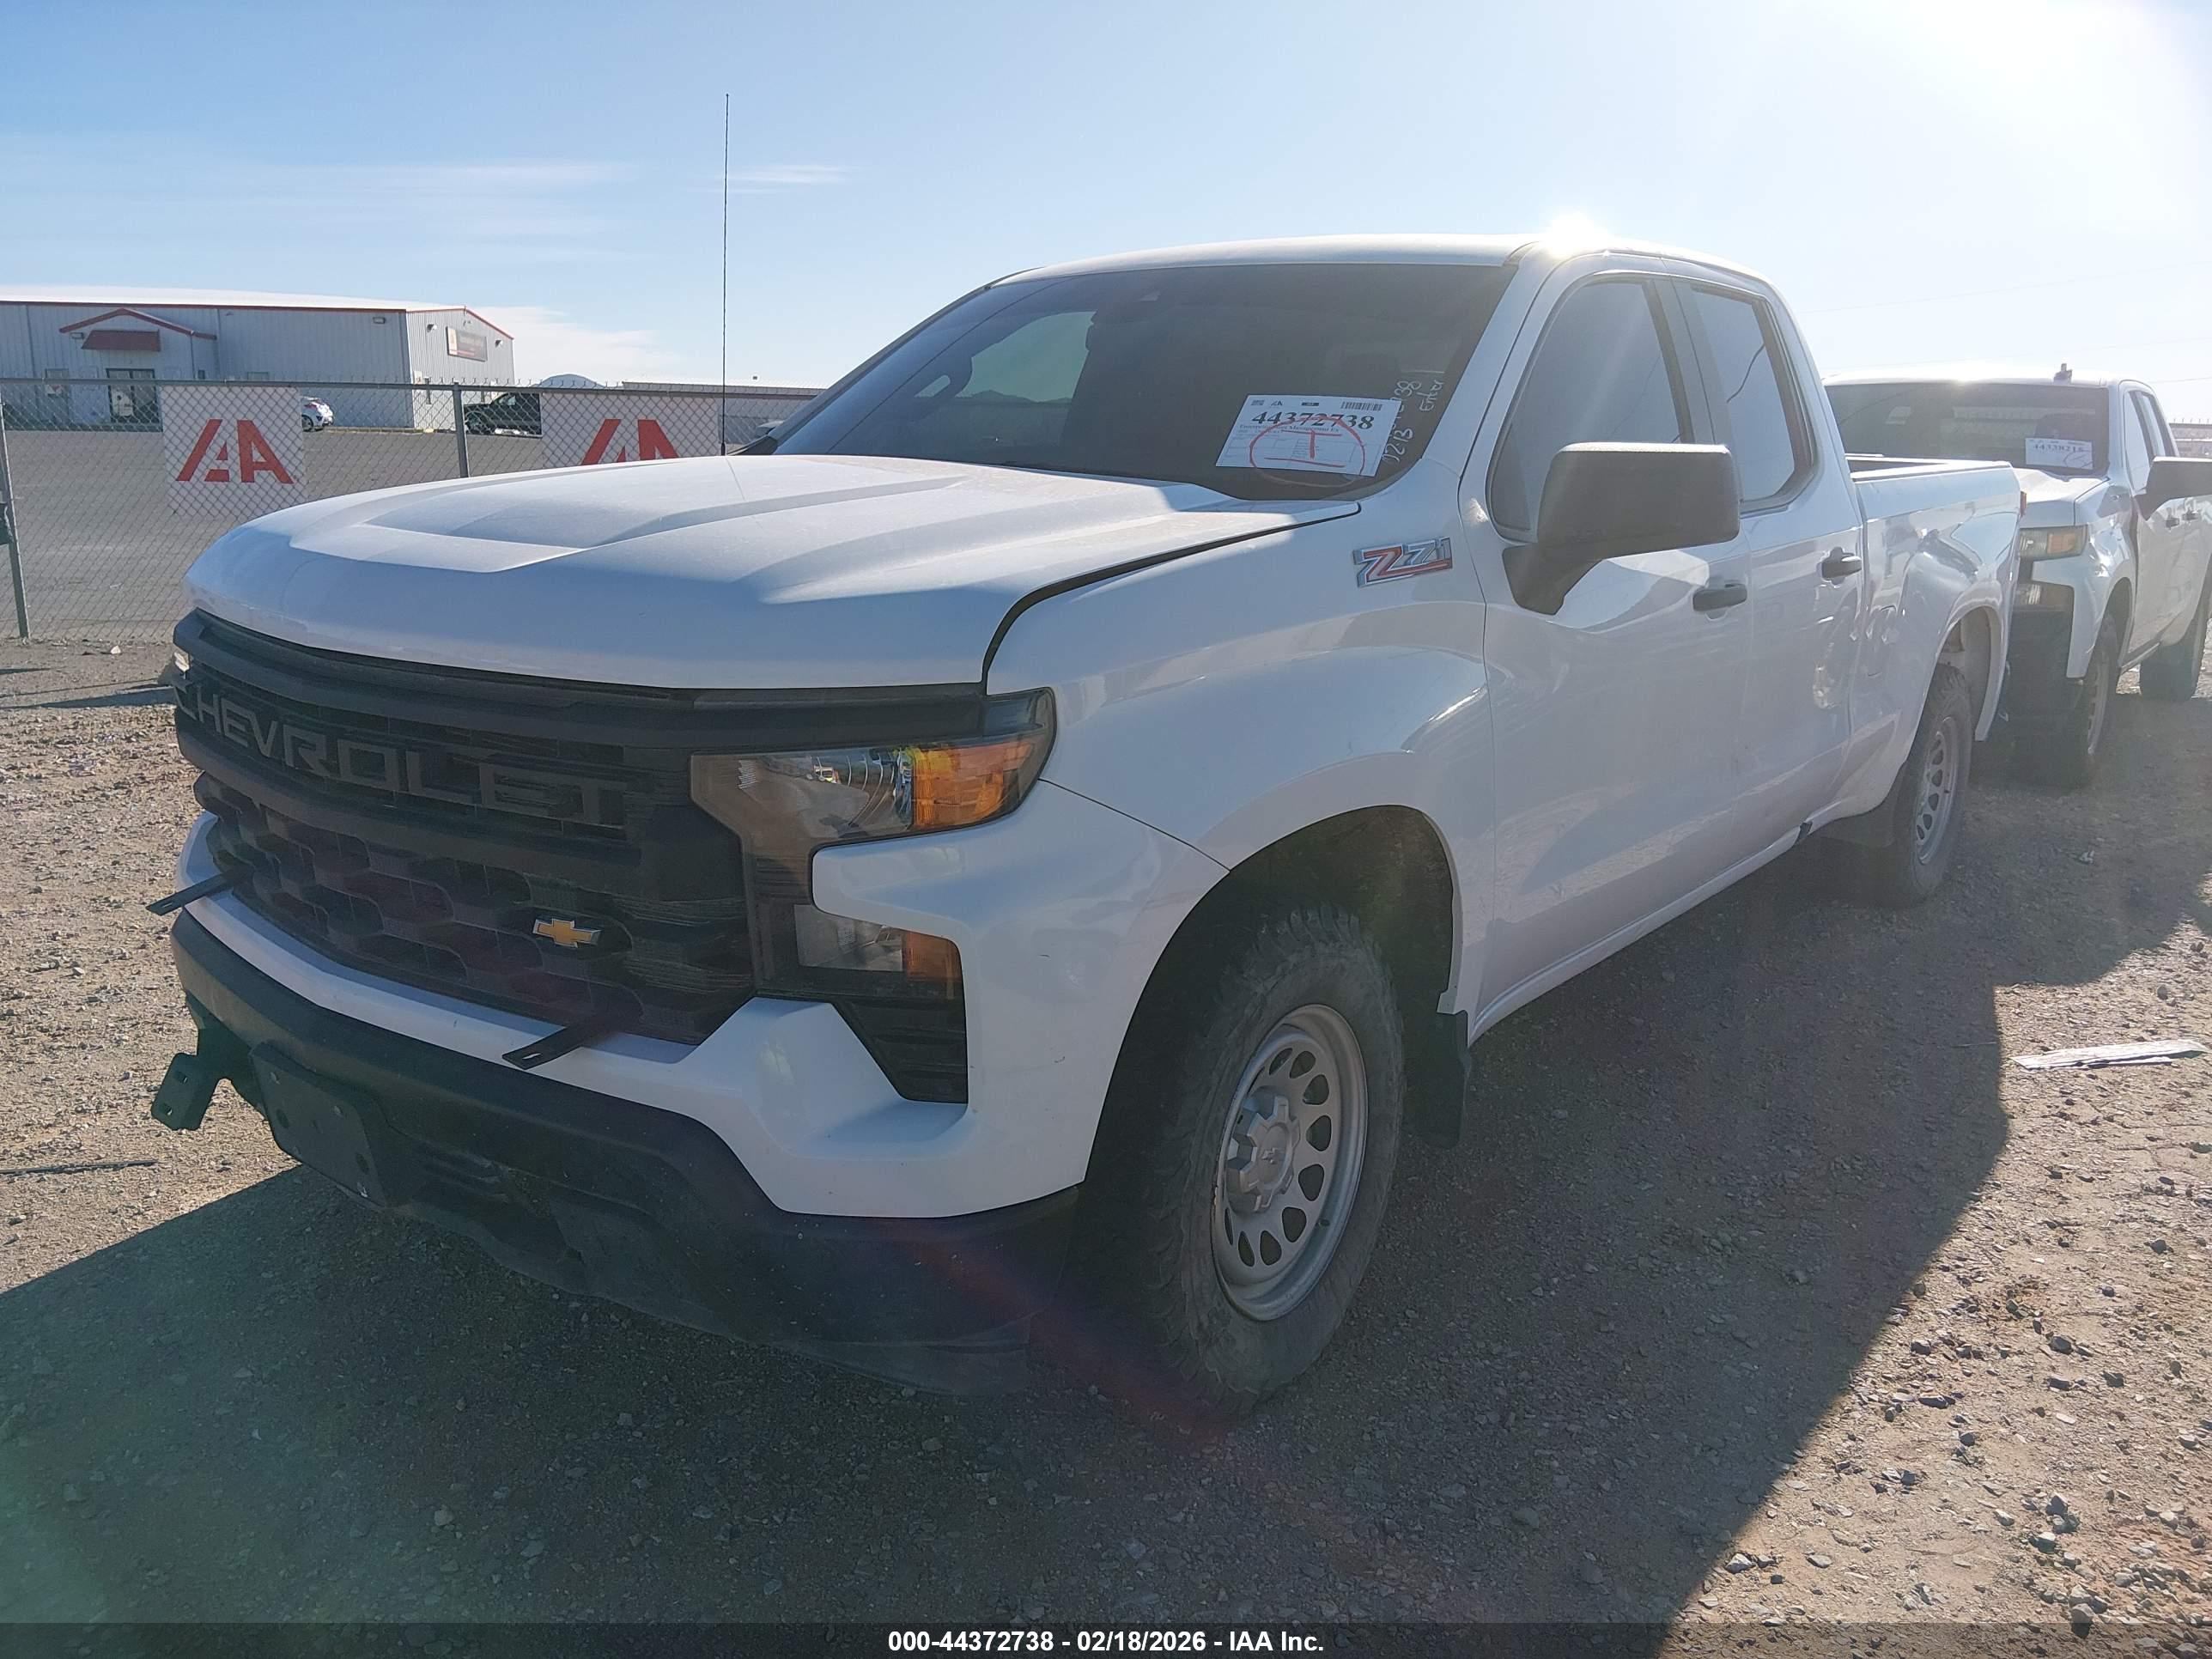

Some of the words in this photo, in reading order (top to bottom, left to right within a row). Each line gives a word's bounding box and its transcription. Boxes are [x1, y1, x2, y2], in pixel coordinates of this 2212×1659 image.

[1252, 411, 1375, 430] 44372738
[1352, 536, 1453, 588] Z71
[173, 681, 629, 830] CHEVROLET
